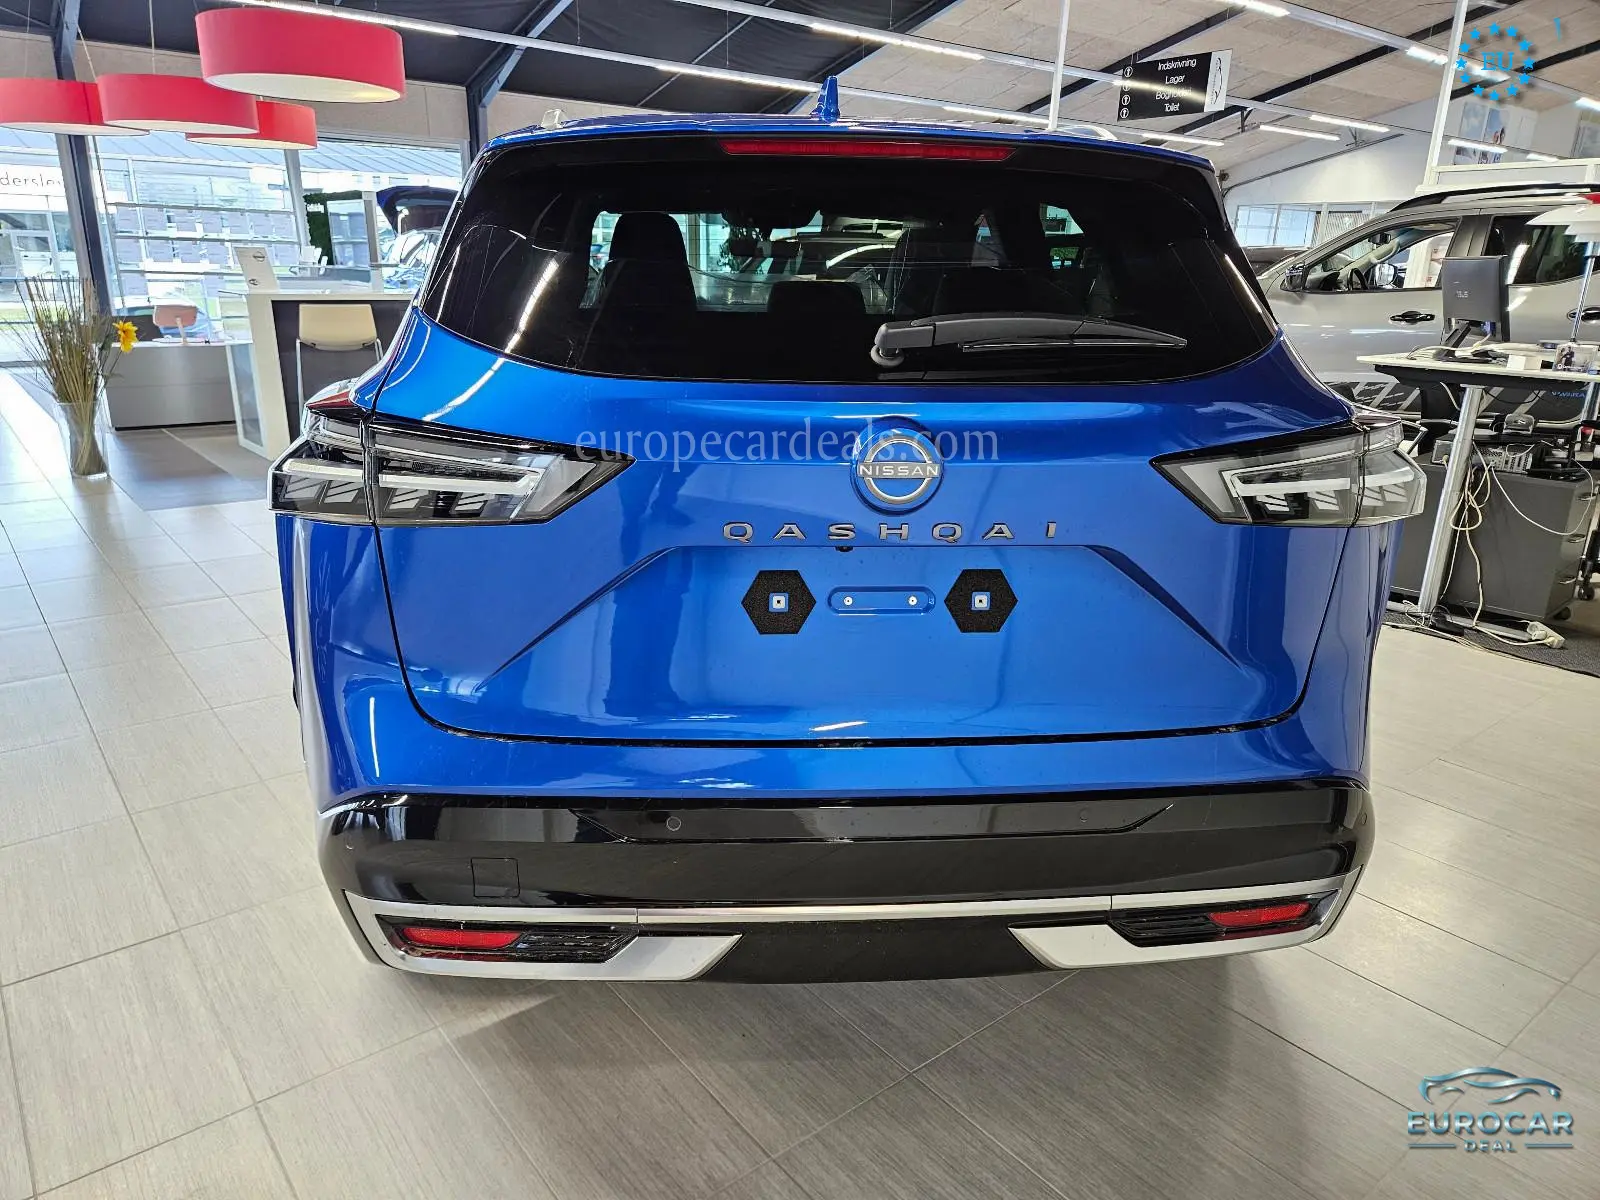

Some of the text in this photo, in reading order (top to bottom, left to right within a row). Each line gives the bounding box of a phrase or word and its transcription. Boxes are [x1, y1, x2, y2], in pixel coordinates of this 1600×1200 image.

[1158, 58, 1197, 71] Indskrivning
[1165, 74, 1185, 85] Lager
[1164, 102, 1180, 112] Toilet
[859, 465, 939, 476] NISSAN
[722, 521, 1057, 543] QASHQAI
